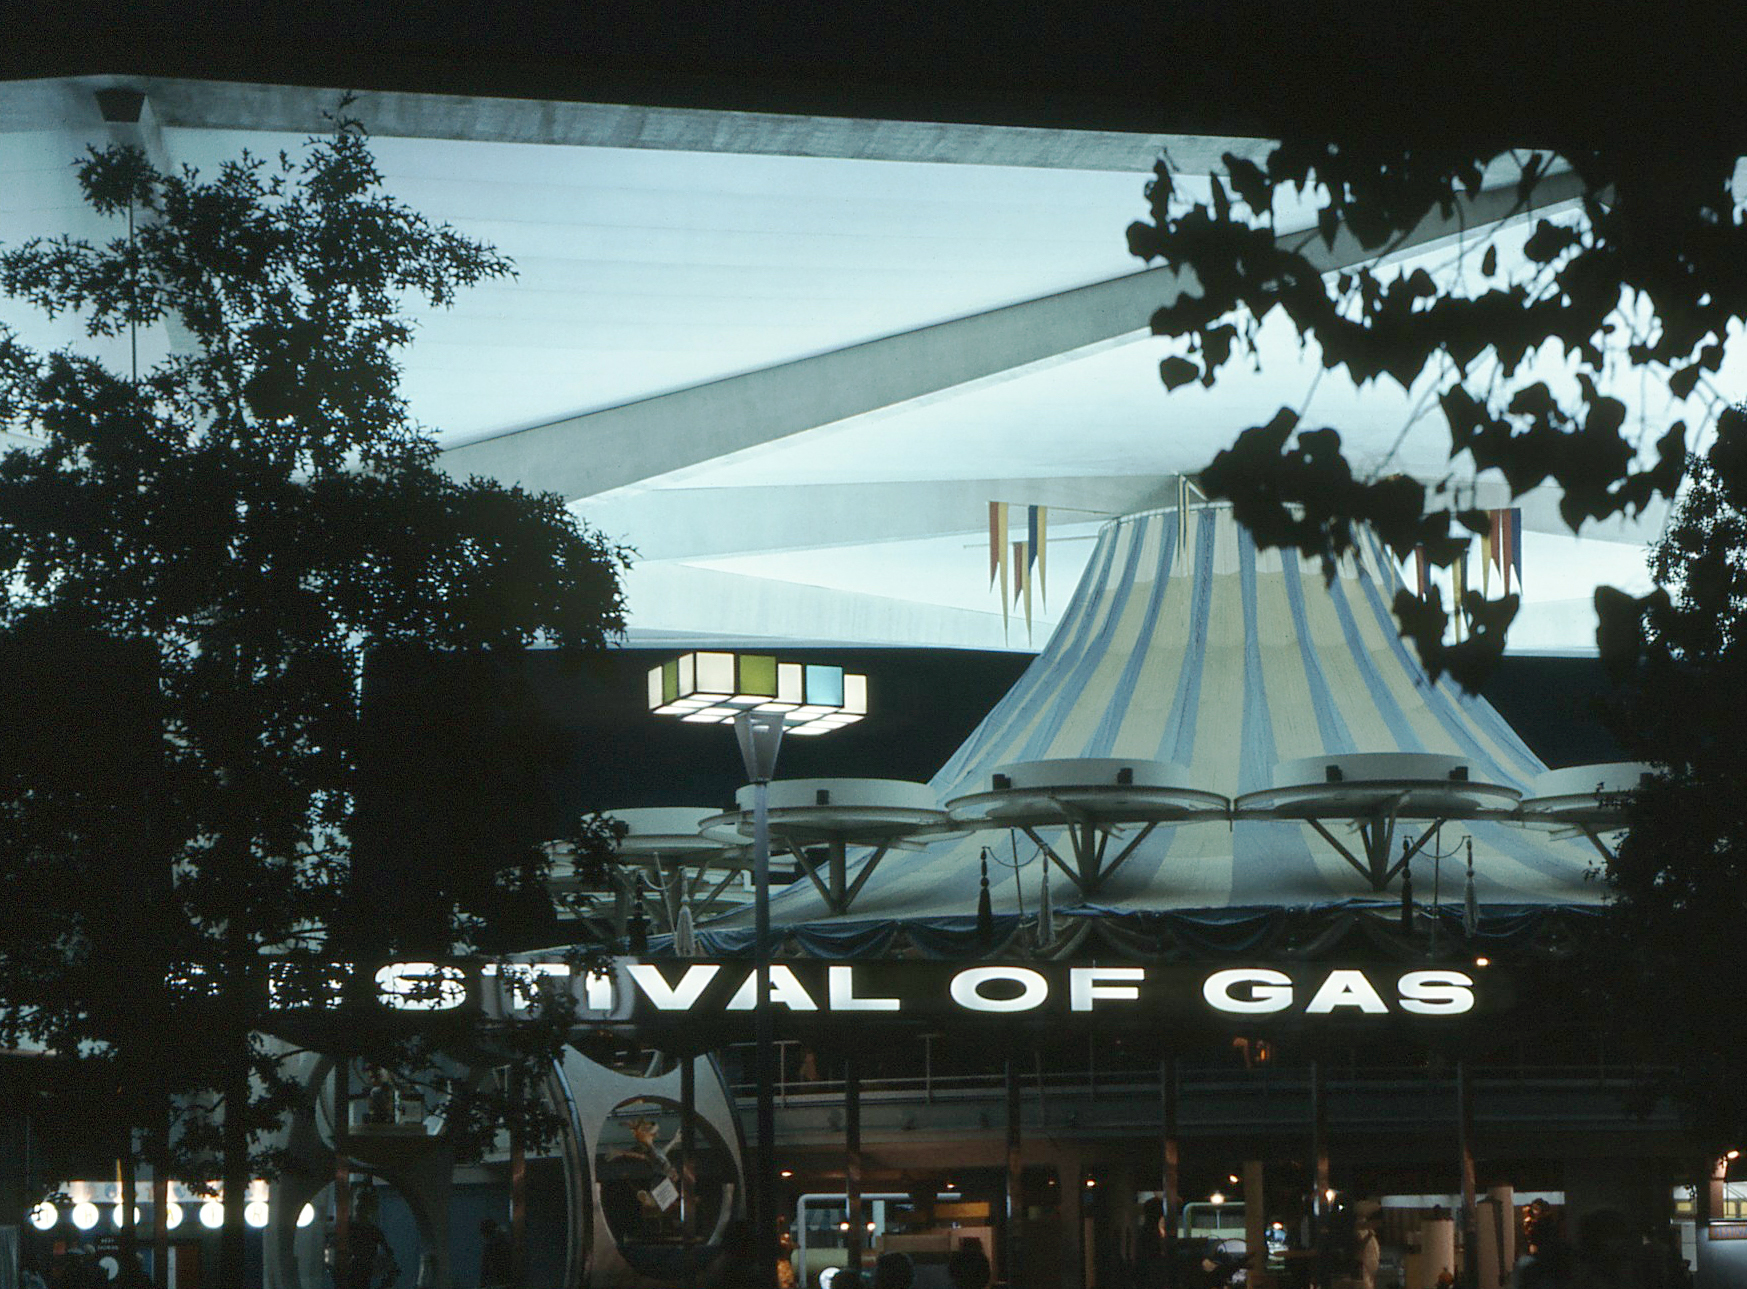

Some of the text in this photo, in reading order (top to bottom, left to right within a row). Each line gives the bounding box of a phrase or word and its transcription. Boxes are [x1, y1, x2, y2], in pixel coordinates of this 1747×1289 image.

[165, 961, 1475, 1015] STIVAL OF GAS
